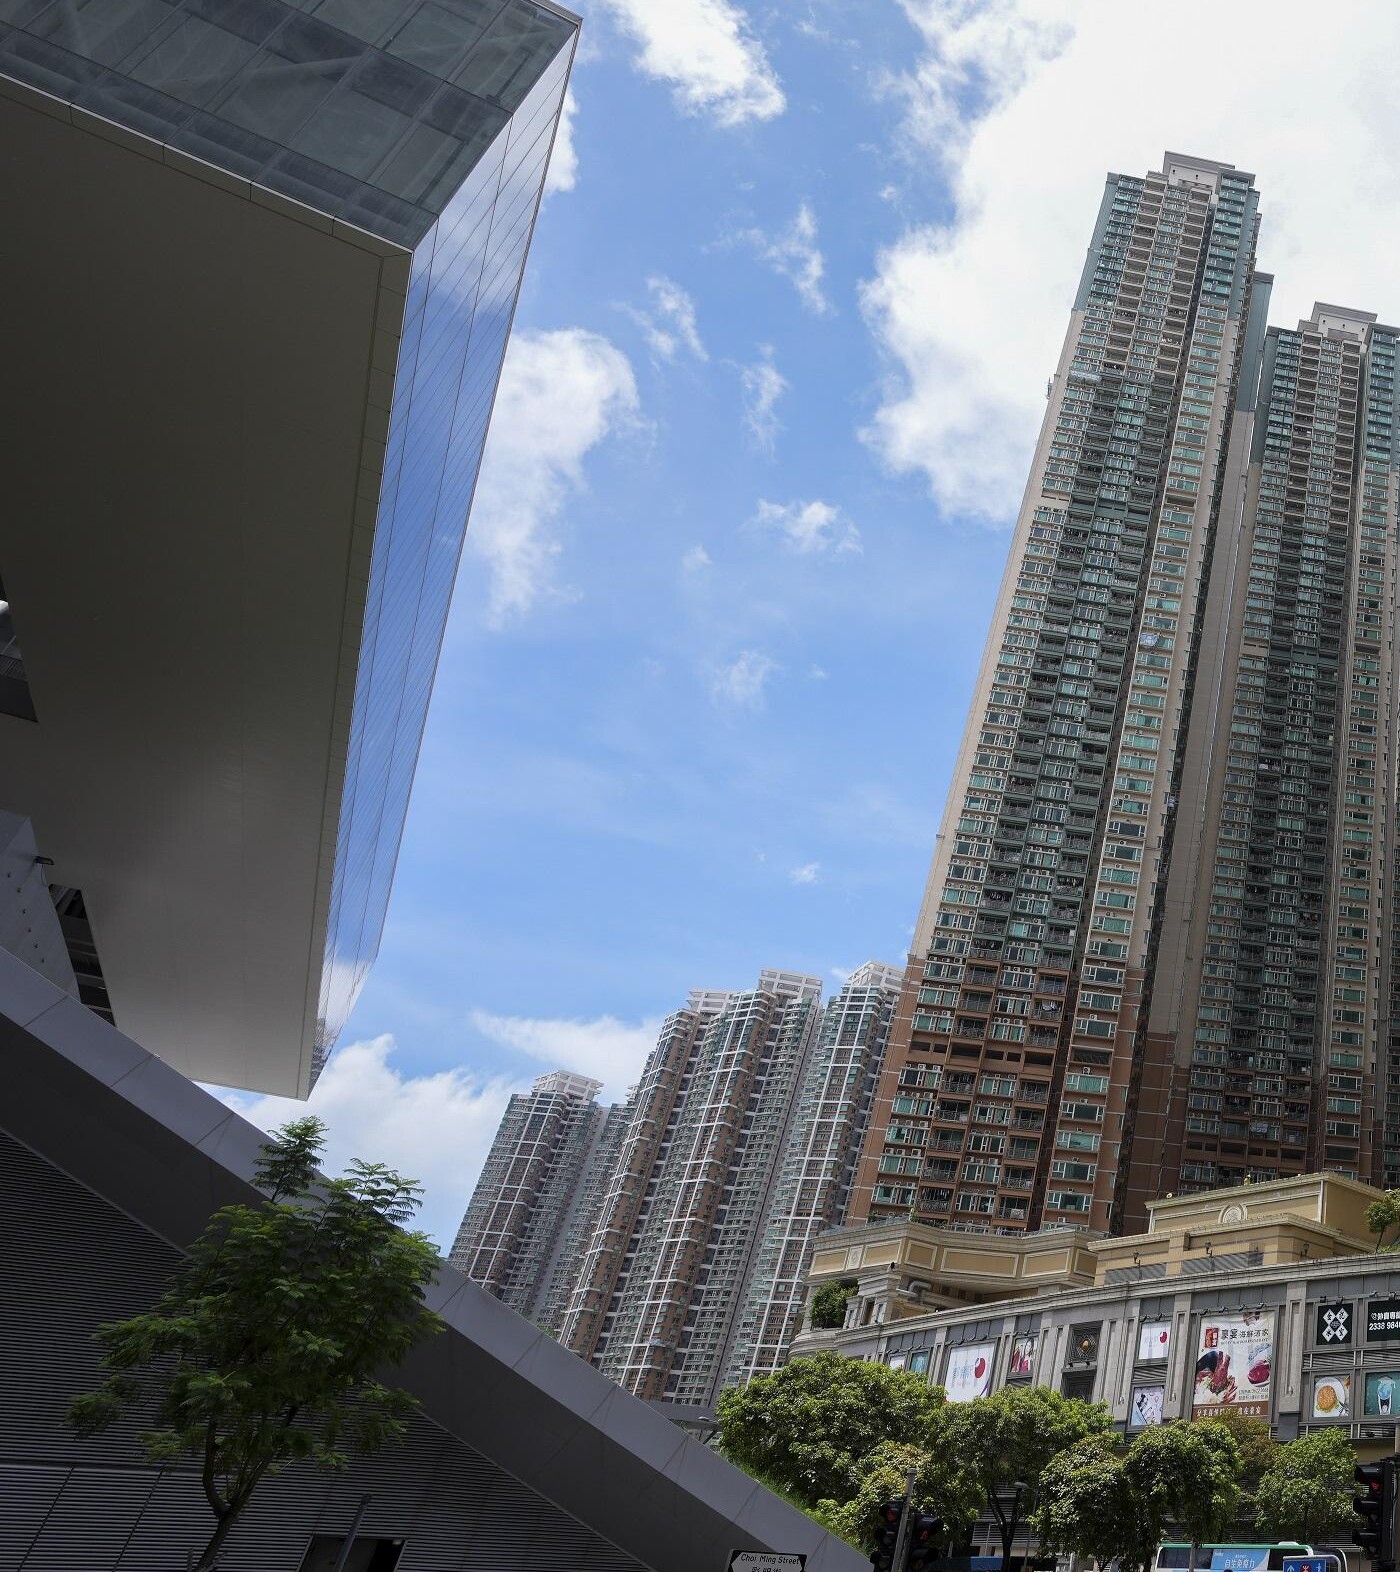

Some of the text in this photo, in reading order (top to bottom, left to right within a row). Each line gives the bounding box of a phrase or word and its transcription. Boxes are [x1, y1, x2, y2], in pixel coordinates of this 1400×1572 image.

[741, 1554, 799, 1564] Choi Ming Street
